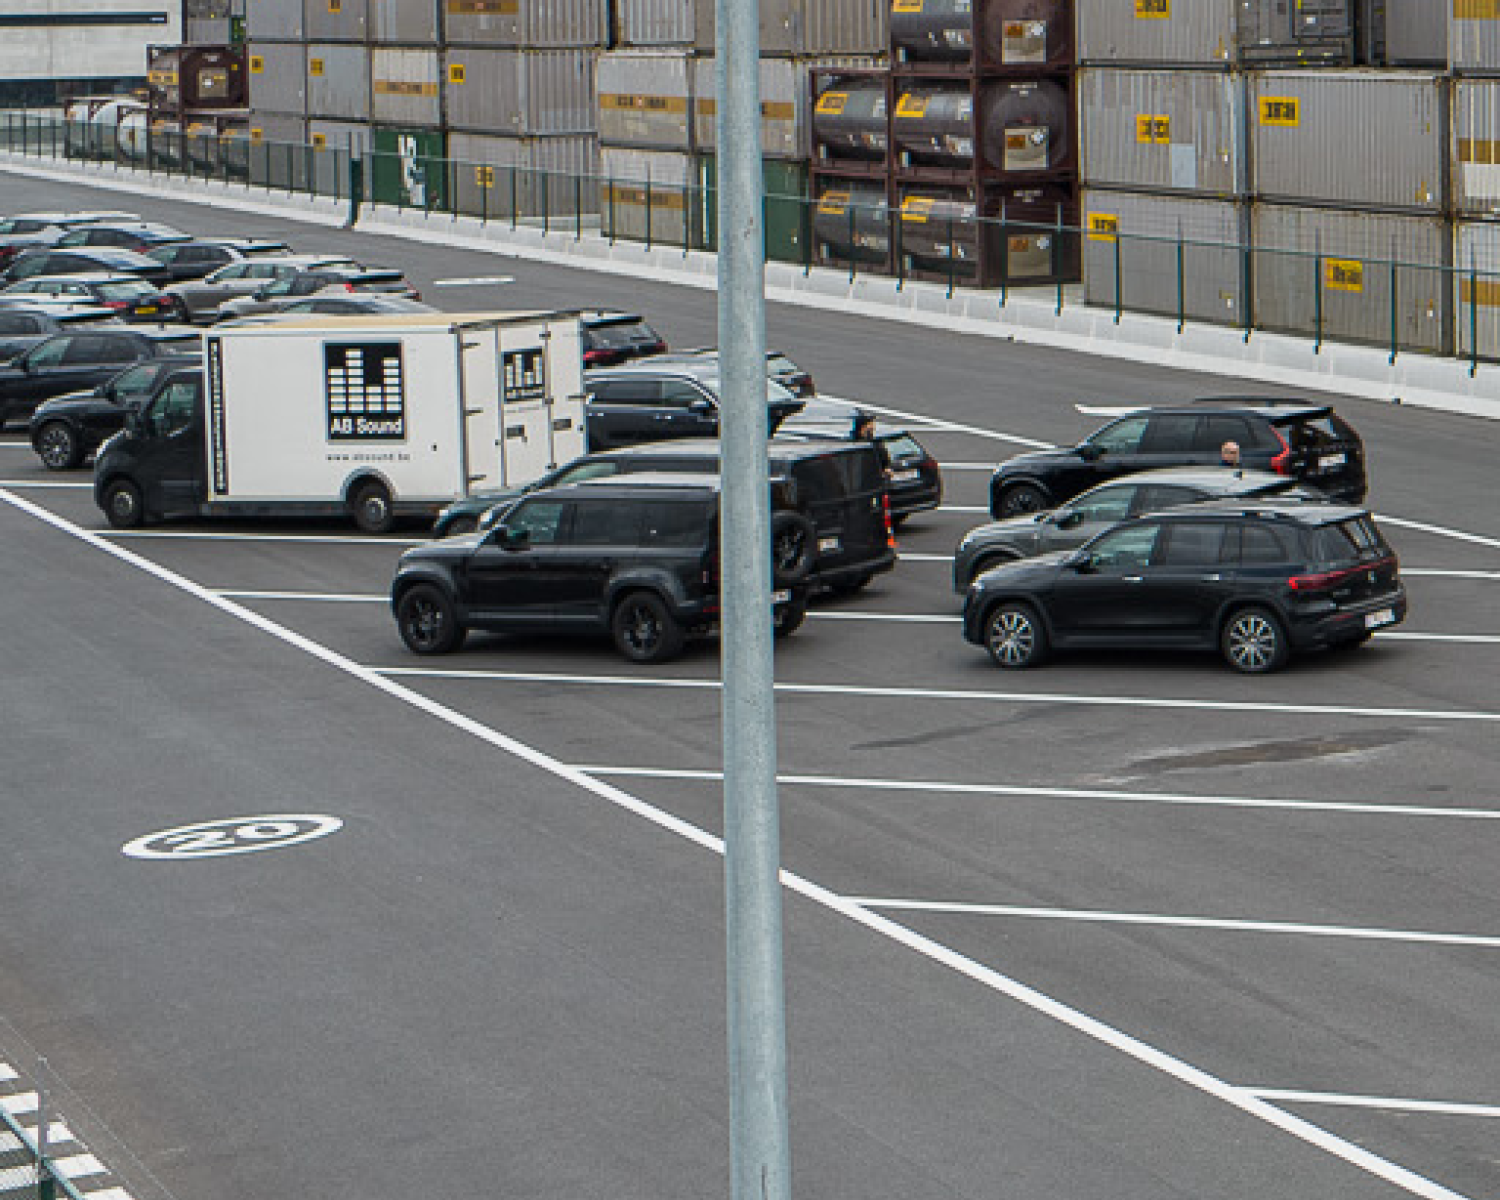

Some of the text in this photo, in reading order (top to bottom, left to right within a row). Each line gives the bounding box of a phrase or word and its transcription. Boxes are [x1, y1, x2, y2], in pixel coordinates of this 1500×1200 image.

[330, 416, 403, 435] AB Sound
[165, 822, 298, 853] 20
